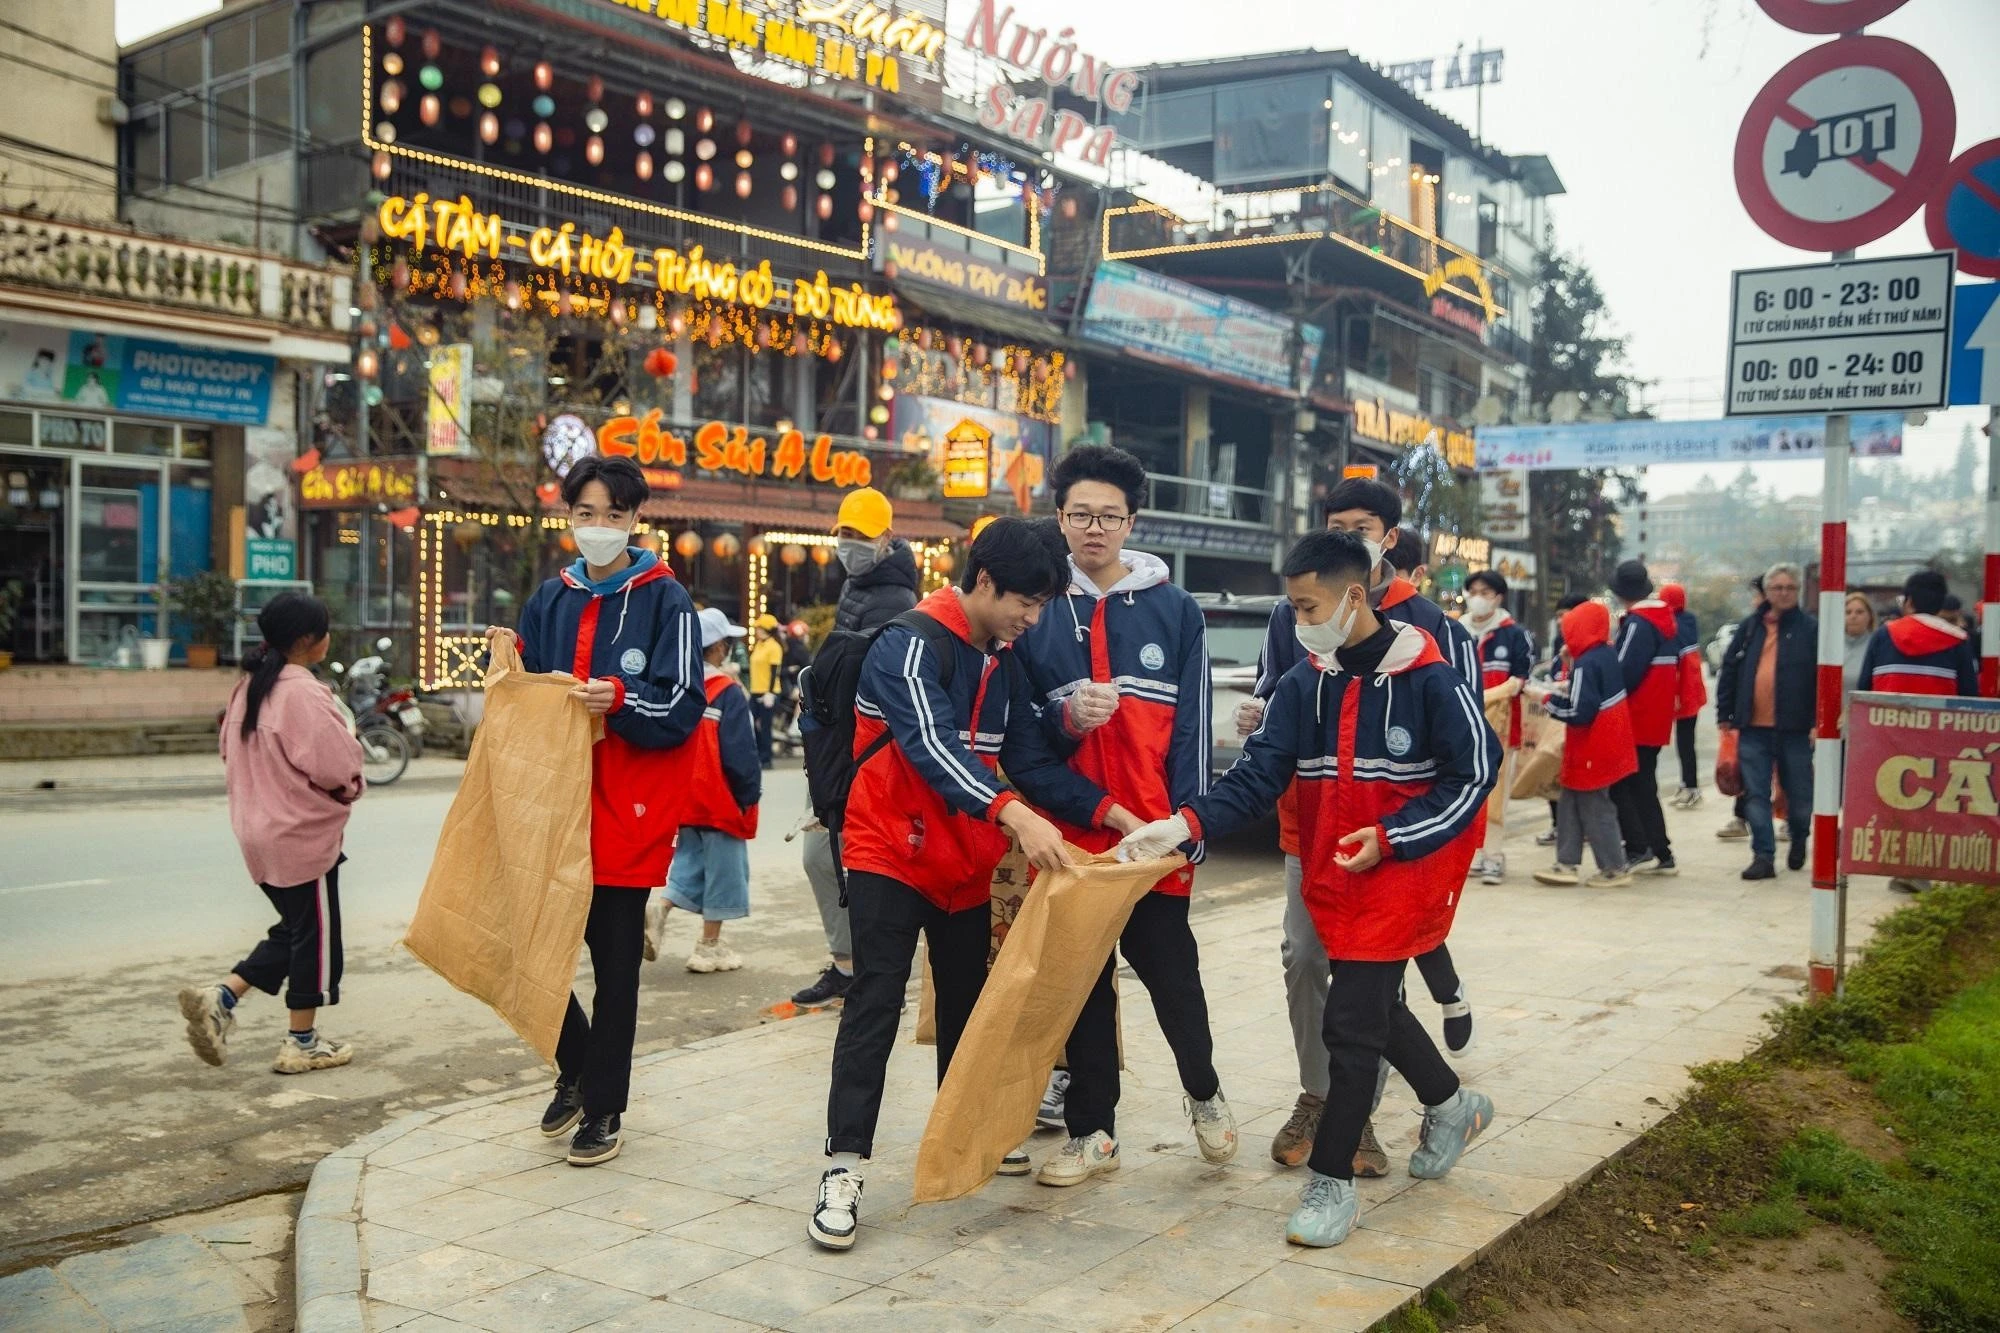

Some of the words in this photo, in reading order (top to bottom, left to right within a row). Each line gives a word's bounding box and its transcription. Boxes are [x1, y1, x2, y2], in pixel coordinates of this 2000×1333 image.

[824, 36, 857, 80] SA
[866, 50, 899, 93] PA
[1810, 108, 1894, 159] 10T
[379, 192, 430, 250] CÁ
[529, 222, 575, 276] CÁ
[132, 350, 263, 385] PHOTOCOPY
[772, 429, 806, 478] A
[1869, 707, 1932, 730] UBND
[1878, 829, 1903, 864] XE
[1905, 826, 1947, 868] MÁY
